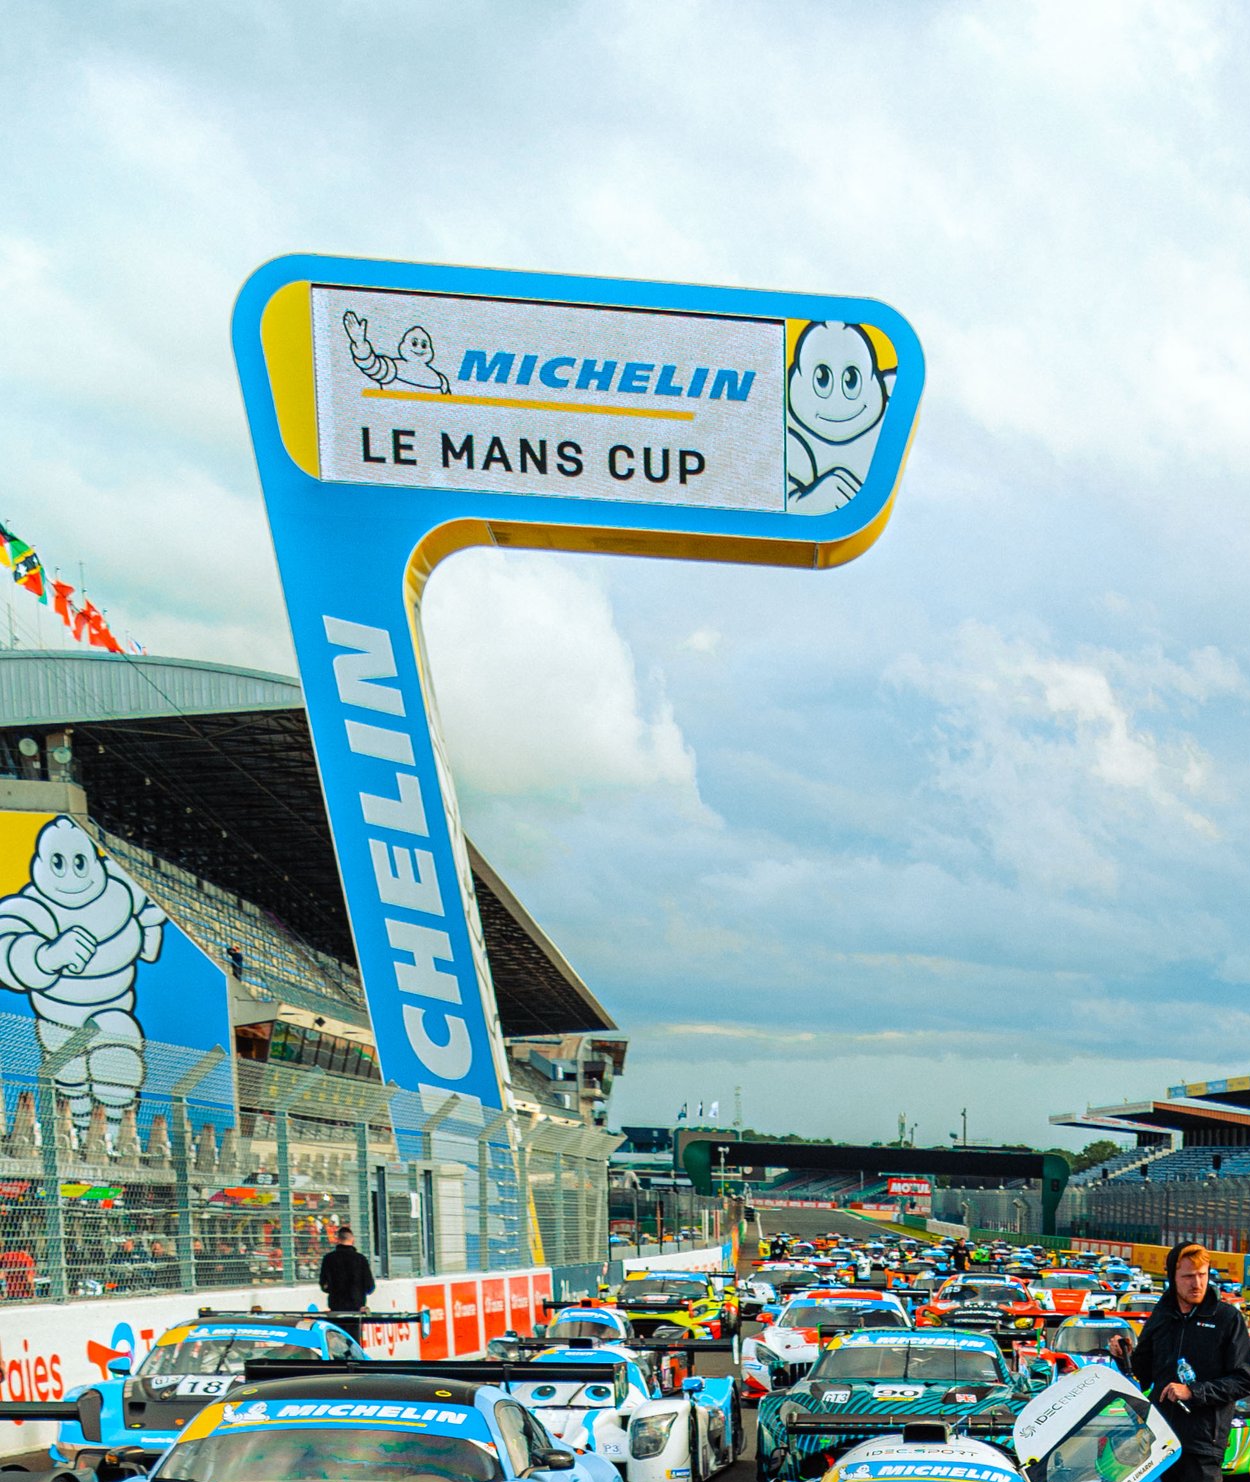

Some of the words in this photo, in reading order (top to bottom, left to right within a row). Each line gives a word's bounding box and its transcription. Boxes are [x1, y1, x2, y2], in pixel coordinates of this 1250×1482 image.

[456, 349, 756, 402] MICHELIN
[361, 428, 418, 466] LE
[442, 433, 584, 478] MANS
[609, 443, 706, 486] CUP
[890, 1181, 931, 1195] MOTUL
[876, 1336, 986, 1348] MICHELIN
[187, 1381, 224, 1394] 18
[878, 1388, 919, 1397] 90
[825, 1391, 849, 1403] GT3
[277, 1403, 468, 1425] MICHELIN
